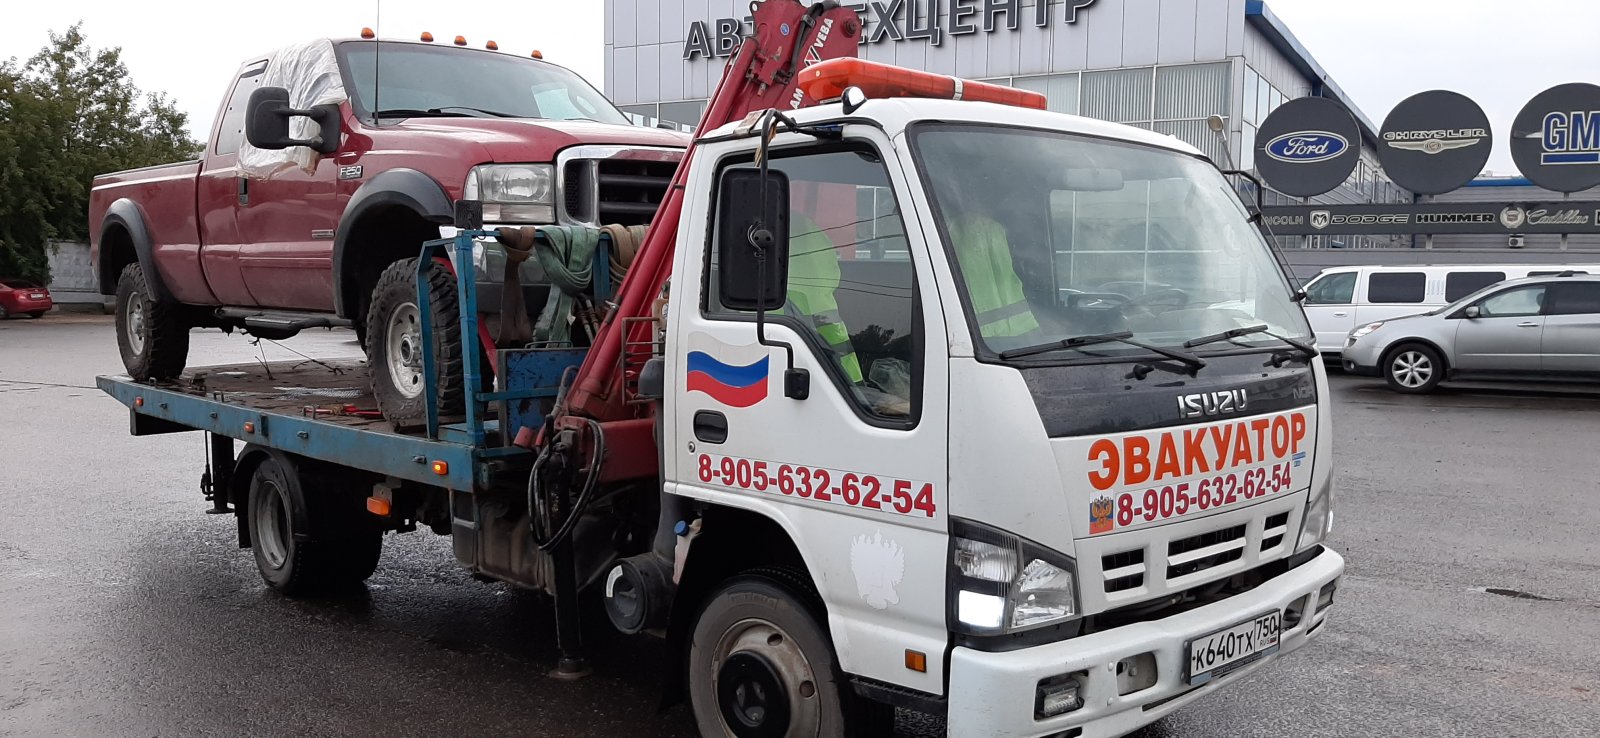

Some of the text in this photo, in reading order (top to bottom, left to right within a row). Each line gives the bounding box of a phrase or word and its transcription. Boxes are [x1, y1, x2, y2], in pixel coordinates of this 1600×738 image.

[814, 18, 833, 48] VEBA
[1383, 128, 1488, 141] CHRYSLER
[1542, 111, 1600, 151] GM
[1283, 137, 1329, 156] Ford
[1331, 214, 1409, 225] DODGE
[1416, 213, 1496, 224] HUMMER
[1526, 209, 1589, 225] Cadillac
[1177, 388, 1248, 419] ISUZU
[1088, 412, 1306, 490] ЭВАКУАТОР
[698, 453, 936, 518] 8-905-632-62-54
[1117, 461, 1291, 527] 8-905-632-62-54
[1256, 615, 1276, 640] 750
